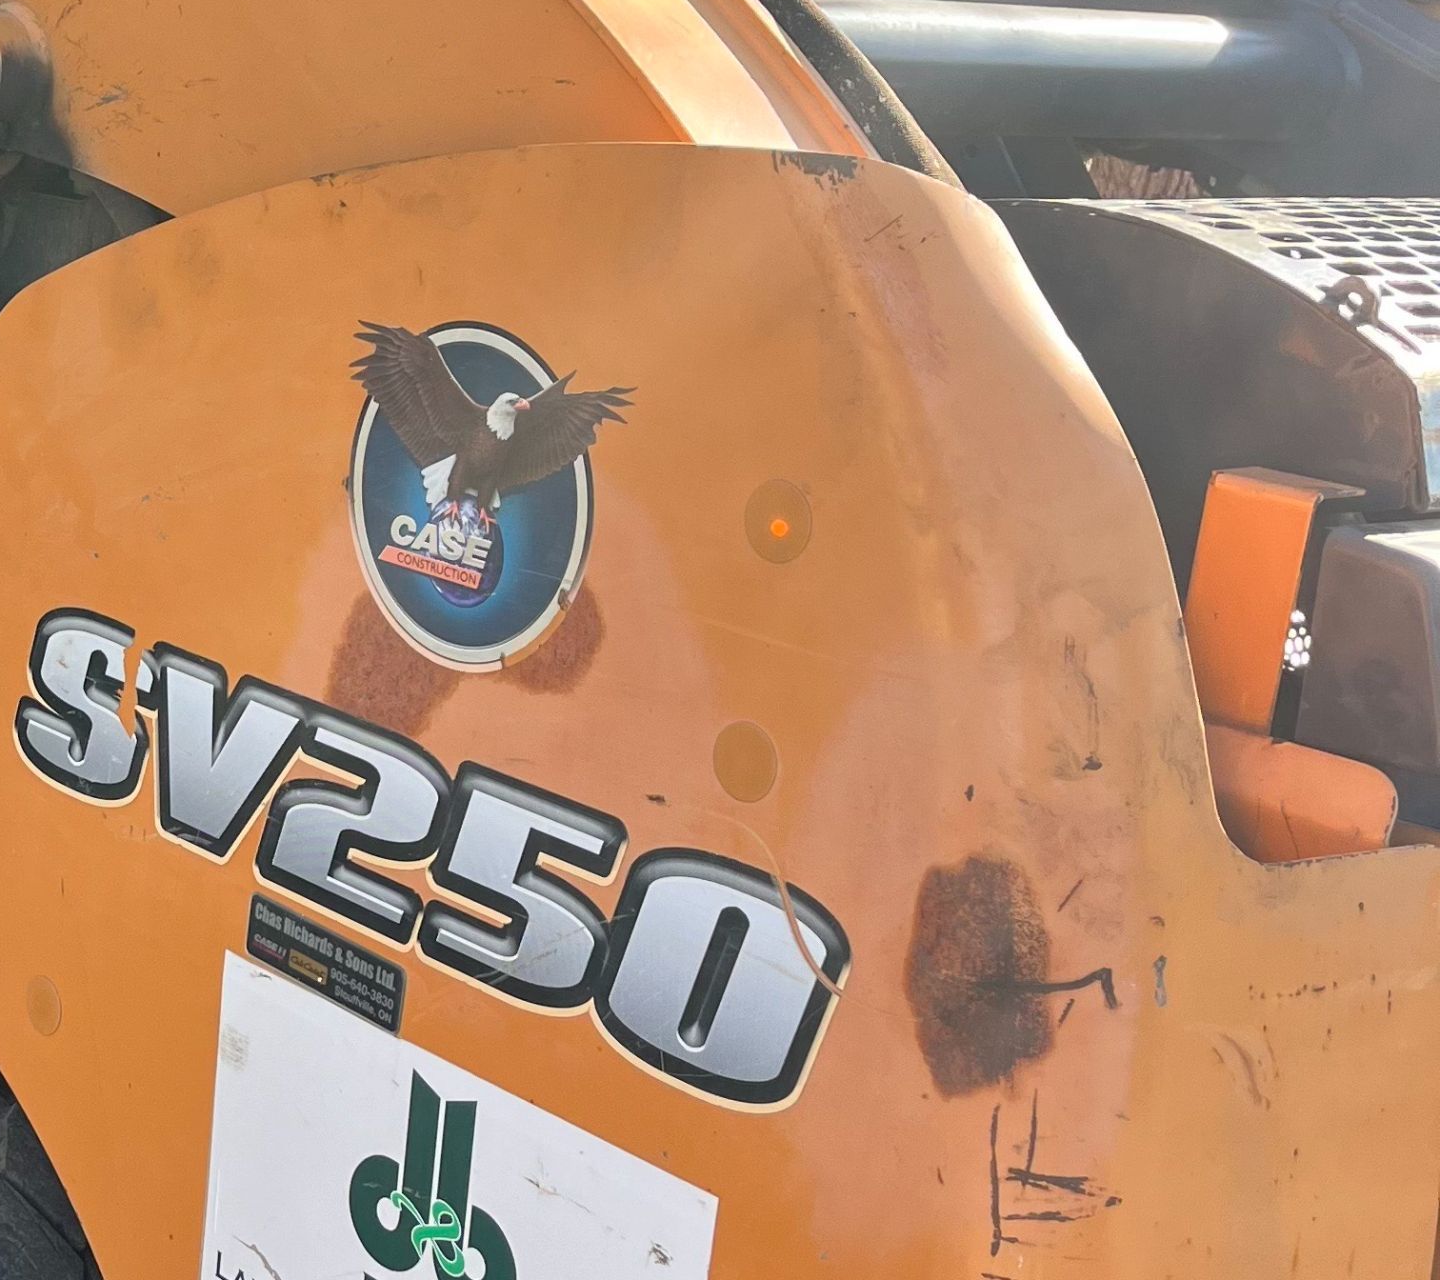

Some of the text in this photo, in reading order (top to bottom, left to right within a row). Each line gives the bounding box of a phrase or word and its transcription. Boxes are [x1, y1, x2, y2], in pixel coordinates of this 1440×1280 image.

[390, 515, 493, 570] CASE
[396, 551, 478, 586] CONSTRUCTION
[16, 608, 850, 1111] SV250
[254, 902, 396, 992] Chas Richards & Sons Ltd.
[330, 967, 394, 1010] 905-640-3830
[378, 1010, 392, 1024] ON
